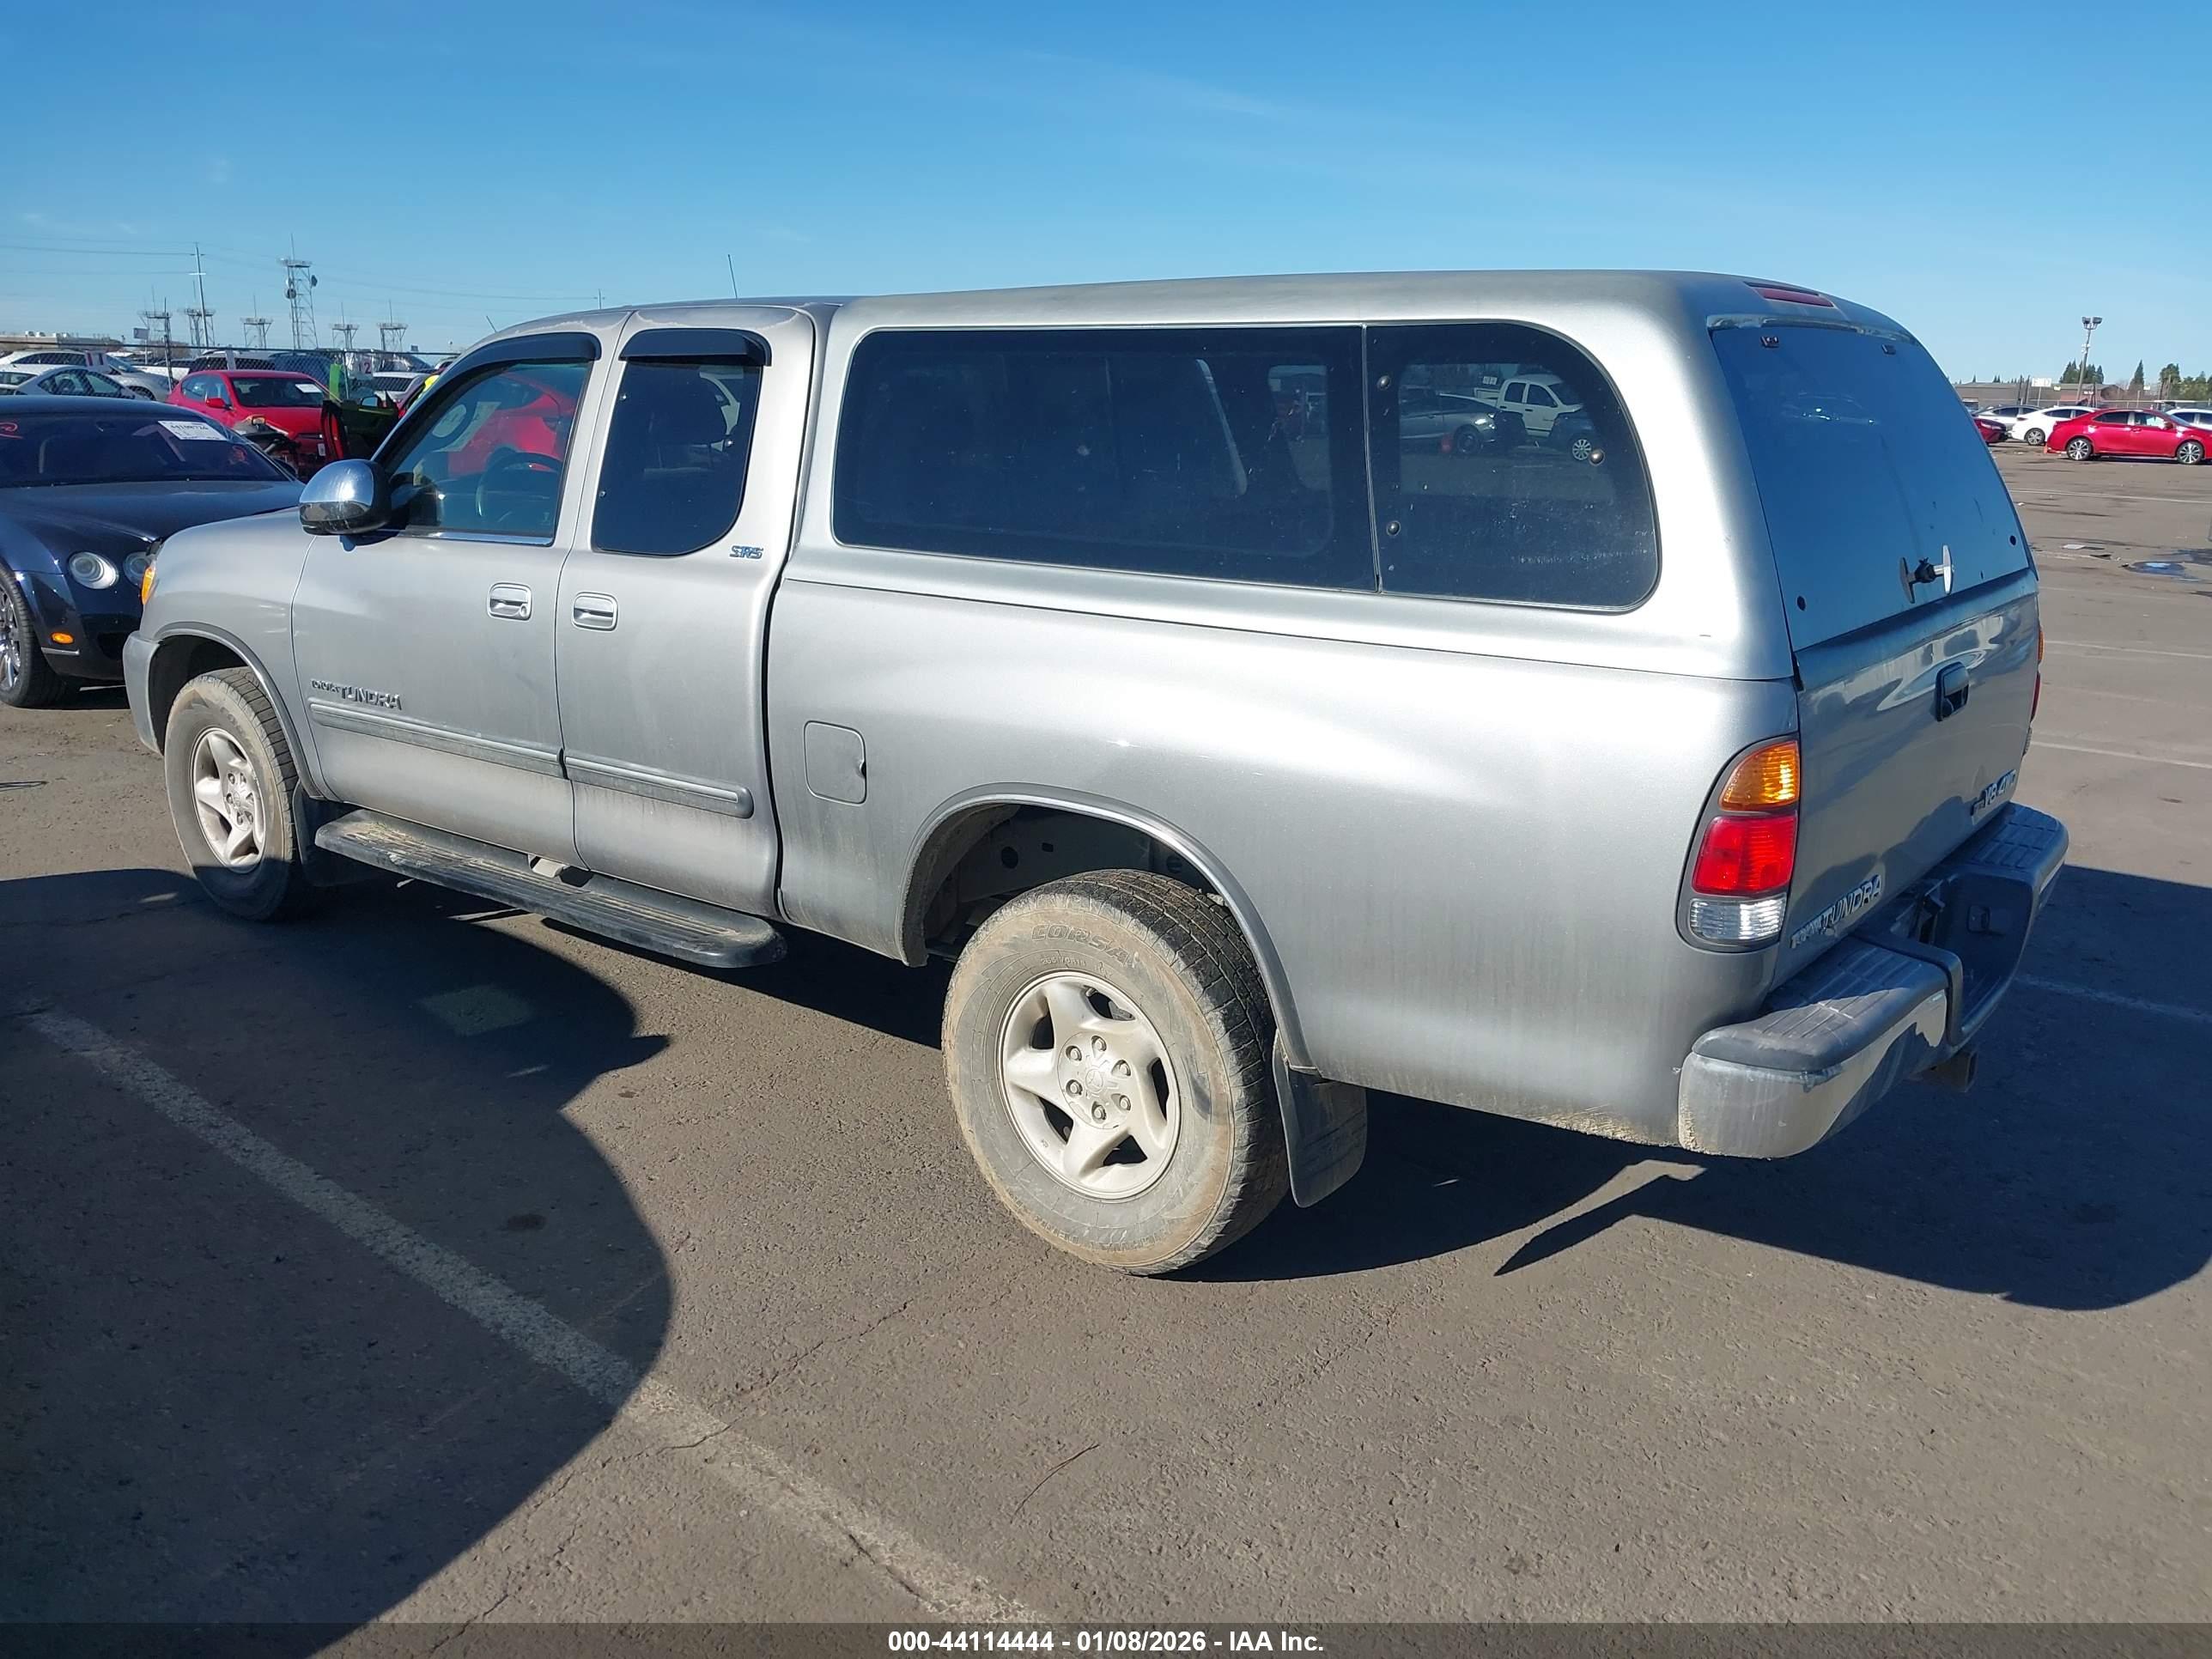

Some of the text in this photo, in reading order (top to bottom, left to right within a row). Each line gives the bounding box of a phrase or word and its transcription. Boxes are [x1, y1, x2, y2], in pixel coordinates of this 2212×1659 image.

[341, 685, 402, 711] TUNDRA
[1820, 874, 1882, 926] TUNDRA
[1031, 923, 1131, 968] CORSA
